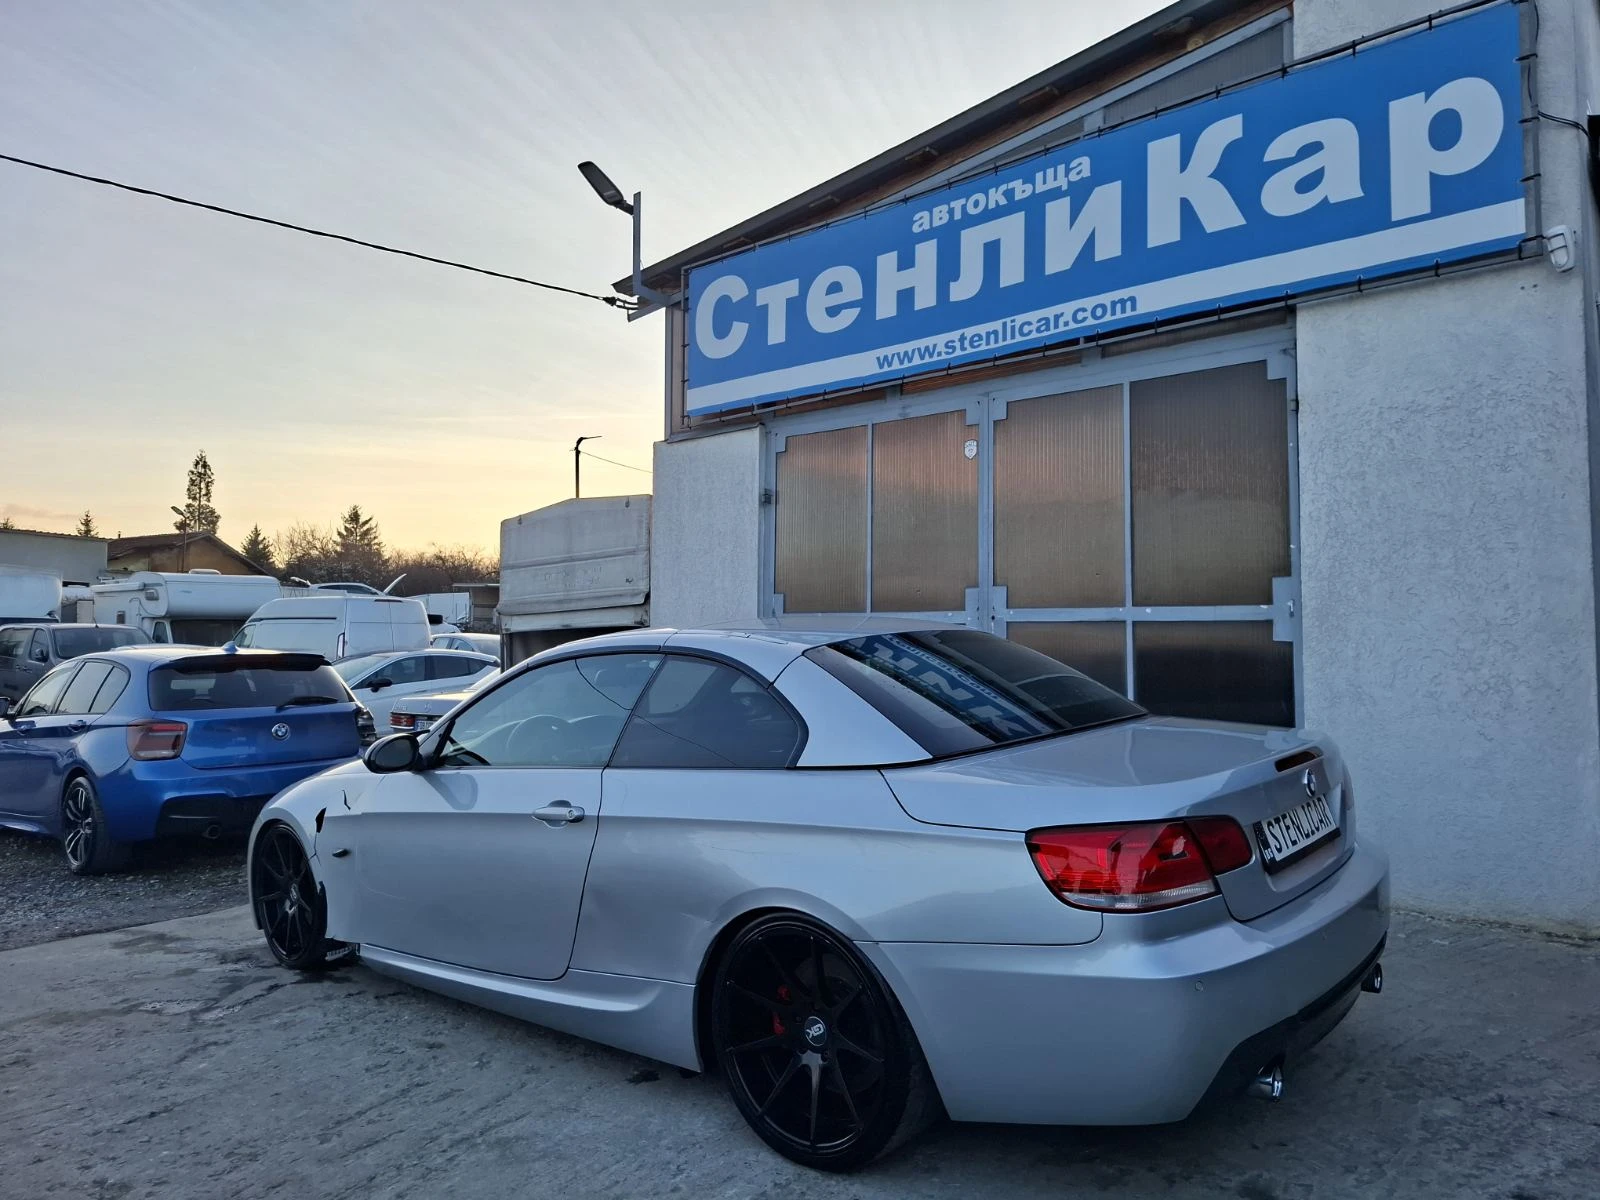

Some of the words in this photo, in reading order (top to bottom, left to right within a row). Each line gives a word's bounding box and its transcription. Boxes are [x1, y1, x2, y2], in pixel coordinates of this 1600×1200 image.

[695, 76, 1505, 360] СтенлиКар
[912, 155, 1092, 234] автокъща
[875, 295, 1138, 371] www.stenlicar.com
[1266, 793, 1332, 854] STENLICAR
